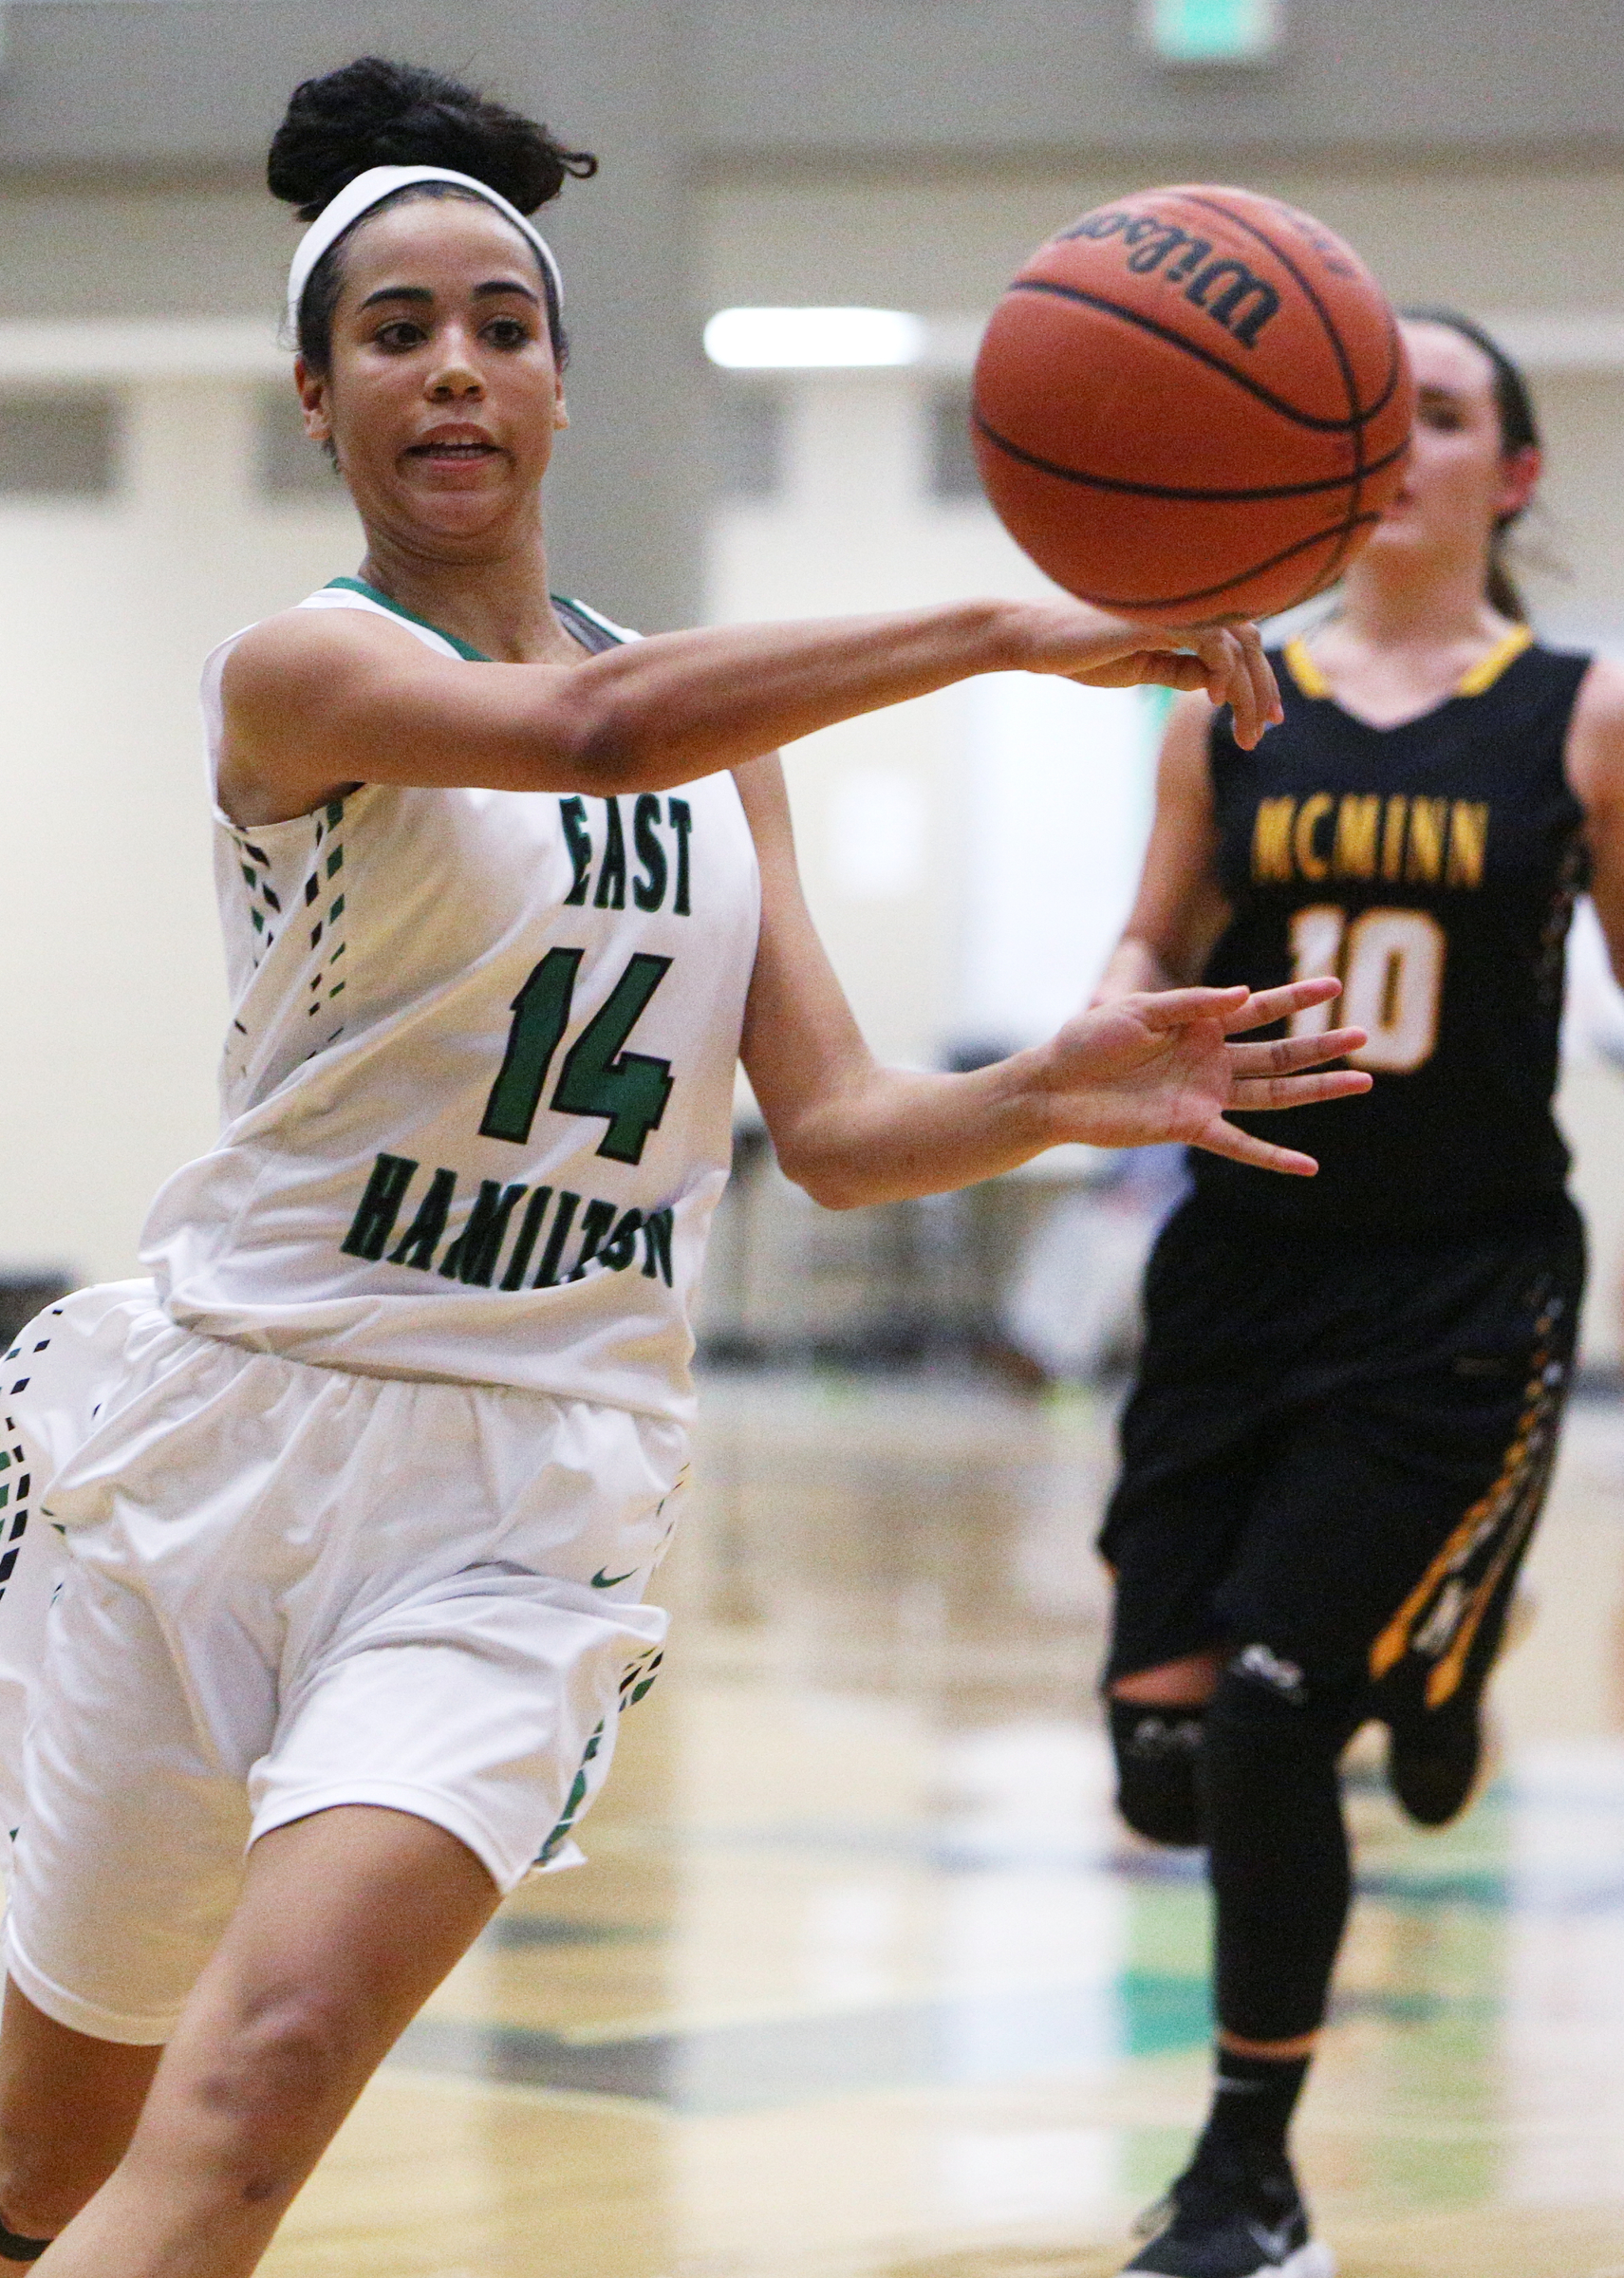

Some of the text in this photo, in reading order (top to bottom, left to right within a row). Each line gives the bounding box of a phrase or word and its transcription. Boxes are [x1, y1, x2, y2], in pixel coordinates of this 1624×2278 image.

[558, 794, 693, 917] EAST
[1250, 792, 1489, 888] MCMINN
[477, 946, 675, 1166] 14
[1287, 902, 1447, 1074] 10
[340, 1151, 675, 1289] HAMILTON
